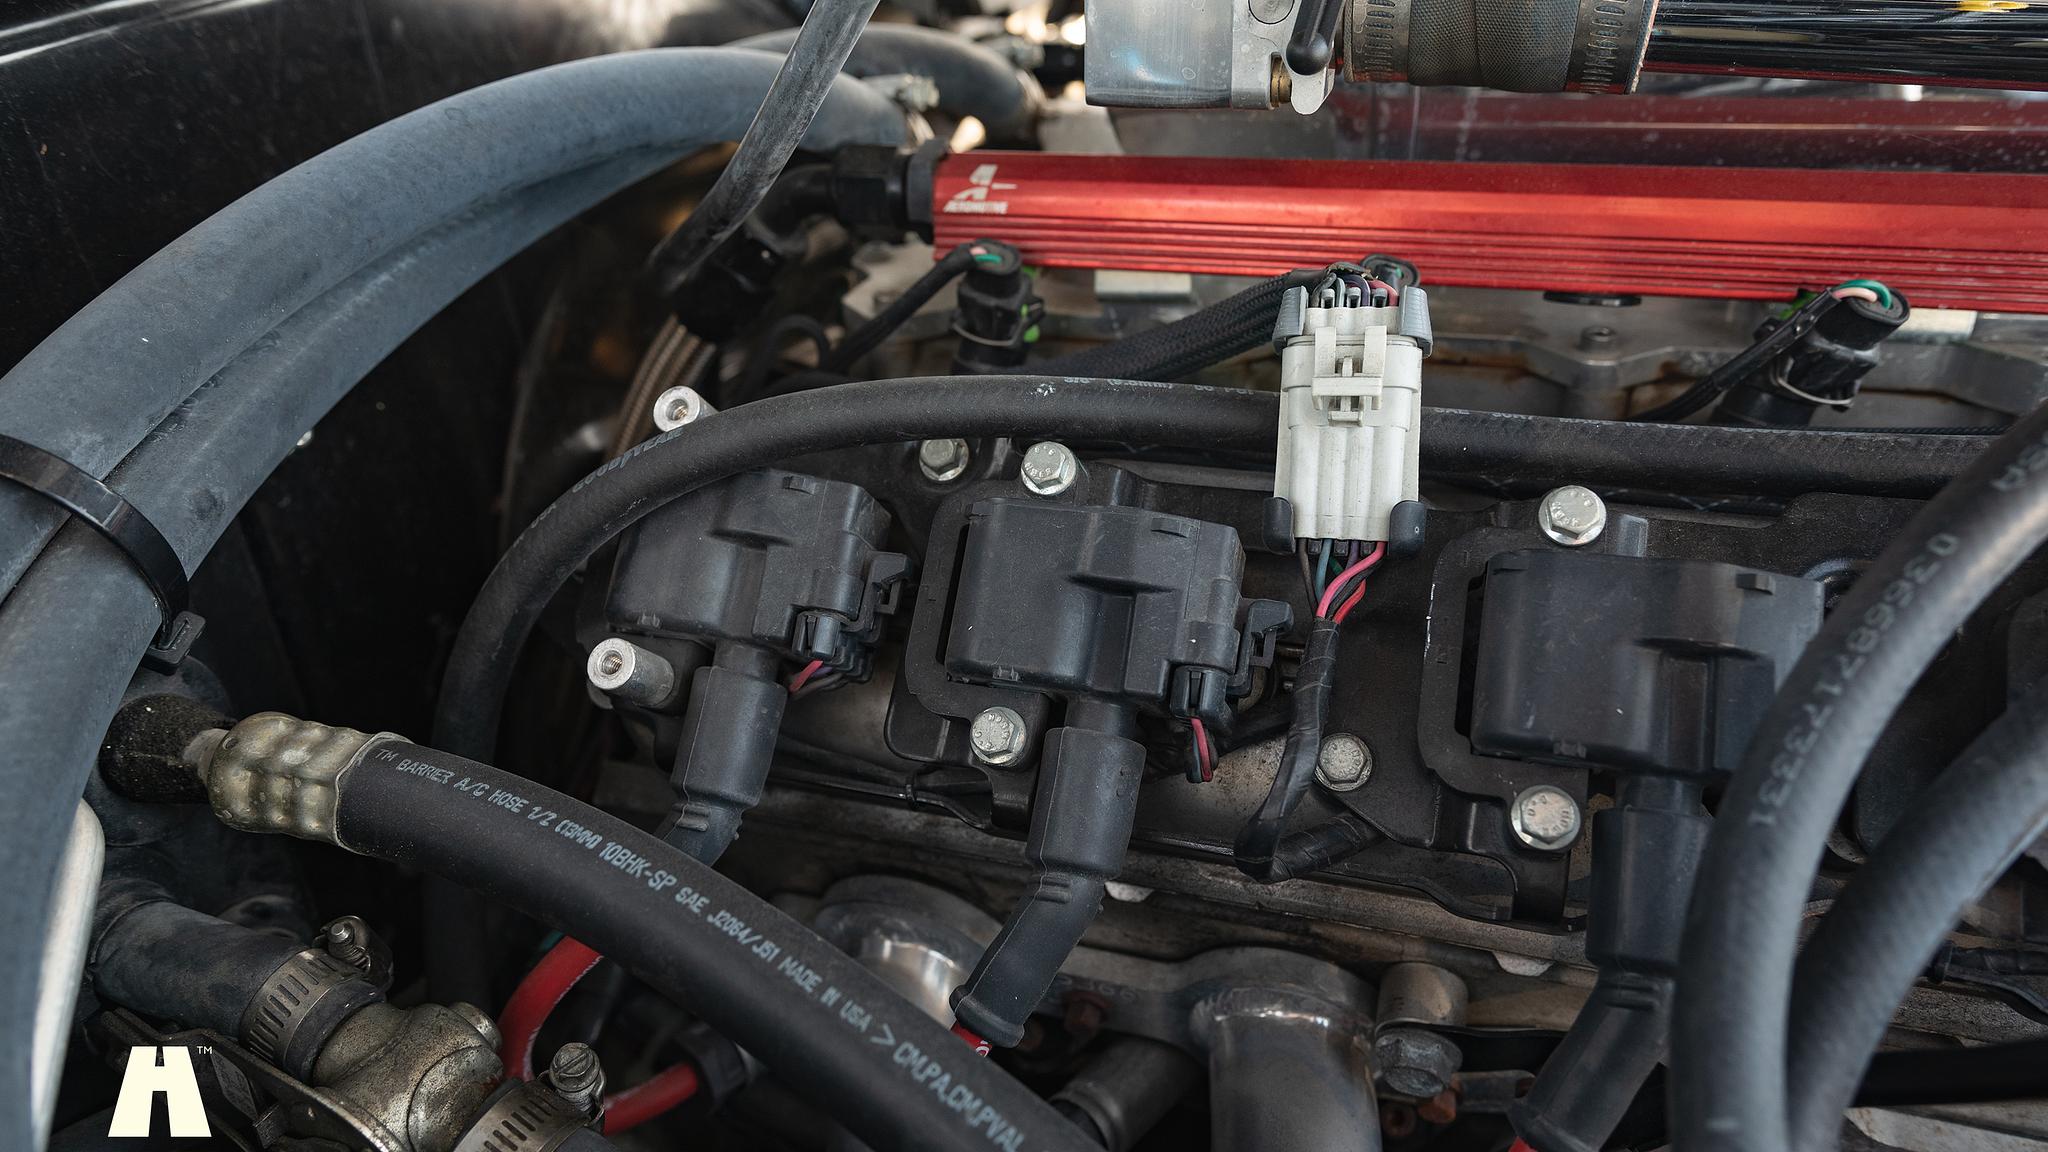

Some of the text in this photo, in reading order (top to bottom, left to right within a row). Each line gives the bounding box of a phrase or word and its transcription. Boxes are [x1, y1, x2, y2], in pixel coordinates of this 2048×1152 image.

[396, 758, 455, 785] BARRIER
[454, 777, 490, 798] A/C
[487, 788, 530, 814] HOSE
[599, 841, 678, 892] 10BHK-SP
[675, 886, 711, 914] SAE
[777, 955, 823, 994] MADE
[820, 986, 842, 1008] IN
[839, 999, 873, 1033] USA
